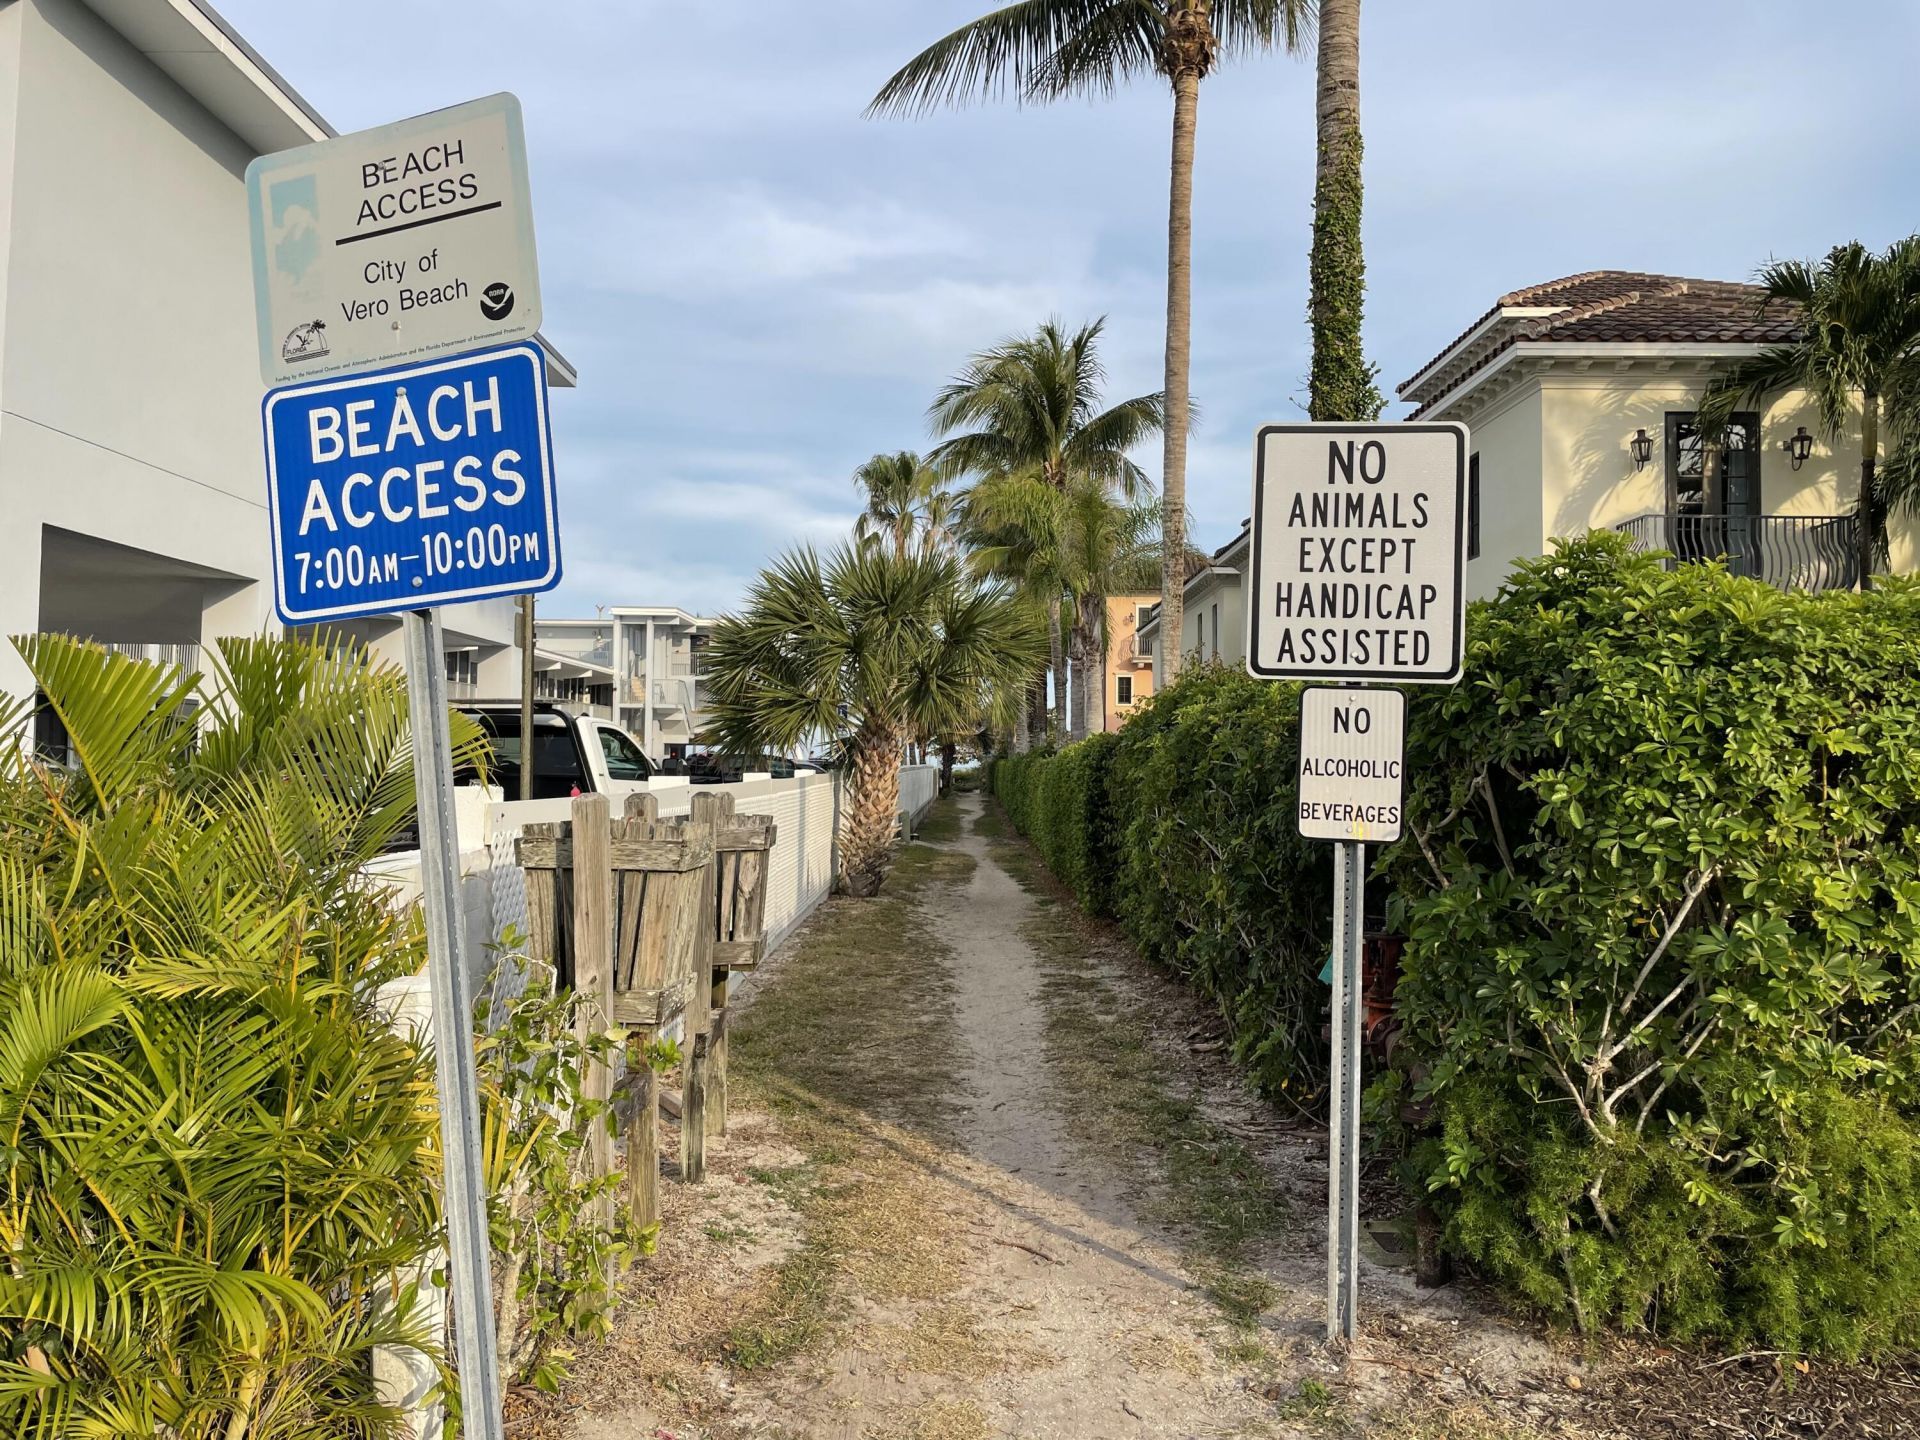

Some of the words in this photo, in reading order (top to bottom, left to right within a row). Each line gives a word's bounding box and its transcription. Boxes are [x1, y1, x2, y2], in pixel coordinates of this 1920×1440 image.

[362, 140, 464, 189] BEACH
[356, 173, 478, 226] ACCESS
[364, 261, 406, 284] City
[418, 248, 438, 272] of
[341, 298, 389, 322] Vero
[399, 278, 468, 311] Beach
[308, 376, 502, 464] BEACH
[1328, 440, 1386, 485] NO
[298, 449, 526, 536] ACCESS
[1287, 492, 1429, 529] ANIMALS
[1299, 537, 1416, 574] EXCEPT
[1275, 582, 1437, 620] HANDICAP
[1277, 627, 1430, 666] ASSISTED
[1333, 706, 1371, 734] NO
[1302, 757, 1400, 779] ALCOHOLIC
[1300, 802, 1398, 824] BEVERAGES
